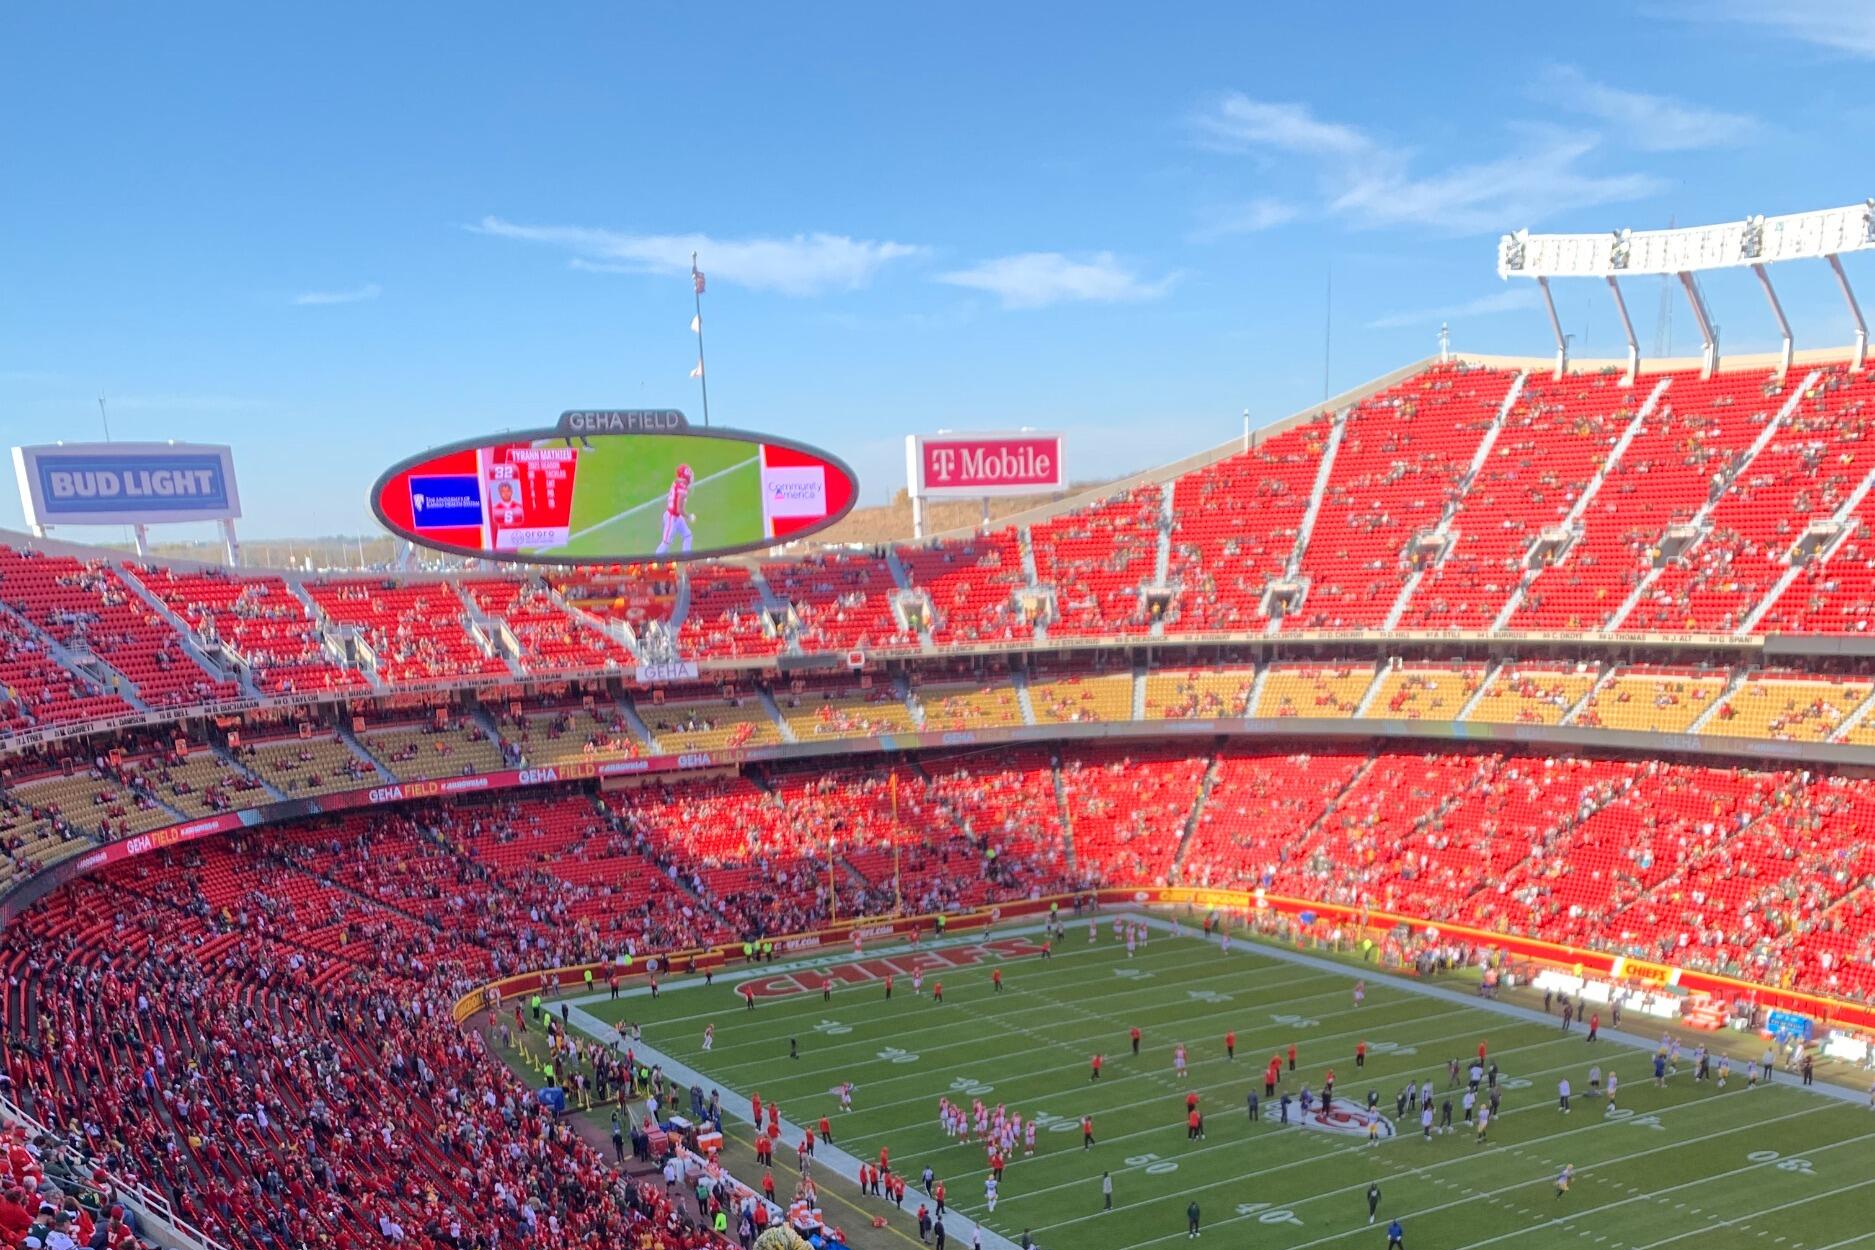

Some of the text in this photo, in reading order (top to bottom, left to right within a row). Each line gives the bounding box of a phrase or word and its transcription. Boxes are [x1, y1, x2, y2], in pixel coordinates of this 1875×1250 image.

[570, 412, 679, 429] GEHA FIELD
[512, 450, 572, 461] TYRANN MATHIEU
[932, 447, 1051, 480] T Mobile
[51, 470, 214, 497] BUD LIGHT
[768, 480, 822, 493] Community
[644, 662, 689, 680] GEHA
[678, 753, 710, 768] GEHA
[519, 768, 556, 785] GEHA
[559, 764, 595, 780] FIELD
[369, 786, 402, 801] GEHA
[404, 782, 438, 798] FIELD
[127, 829, 178, 854] GEHA FIELD
[734, 937, 1050, 999] CHIEFS
[1625, 962, 1667, 982] CHIEFS
[1124, 1153, 1179, 1174] 50
[1747, 1150, 1815, 1172] 30
[1235, 1203, 1295, 1224] 40
